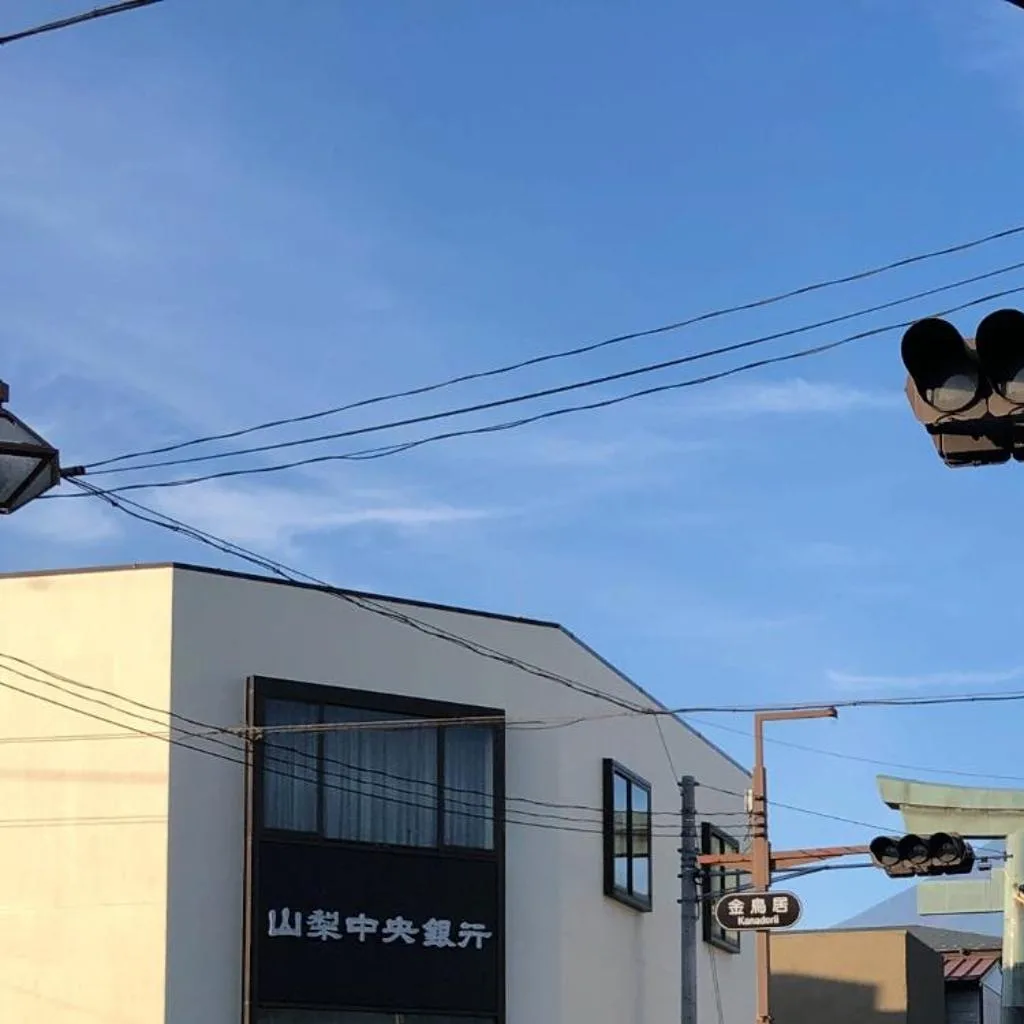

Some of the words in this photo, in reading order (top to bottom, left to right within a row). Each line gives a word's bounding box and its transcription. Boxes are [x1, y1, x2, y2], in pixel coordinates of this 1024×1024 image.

[728, 896, 789, 915] 金鳥居
[268, 907, 493, 949] 山梨中央銀行
